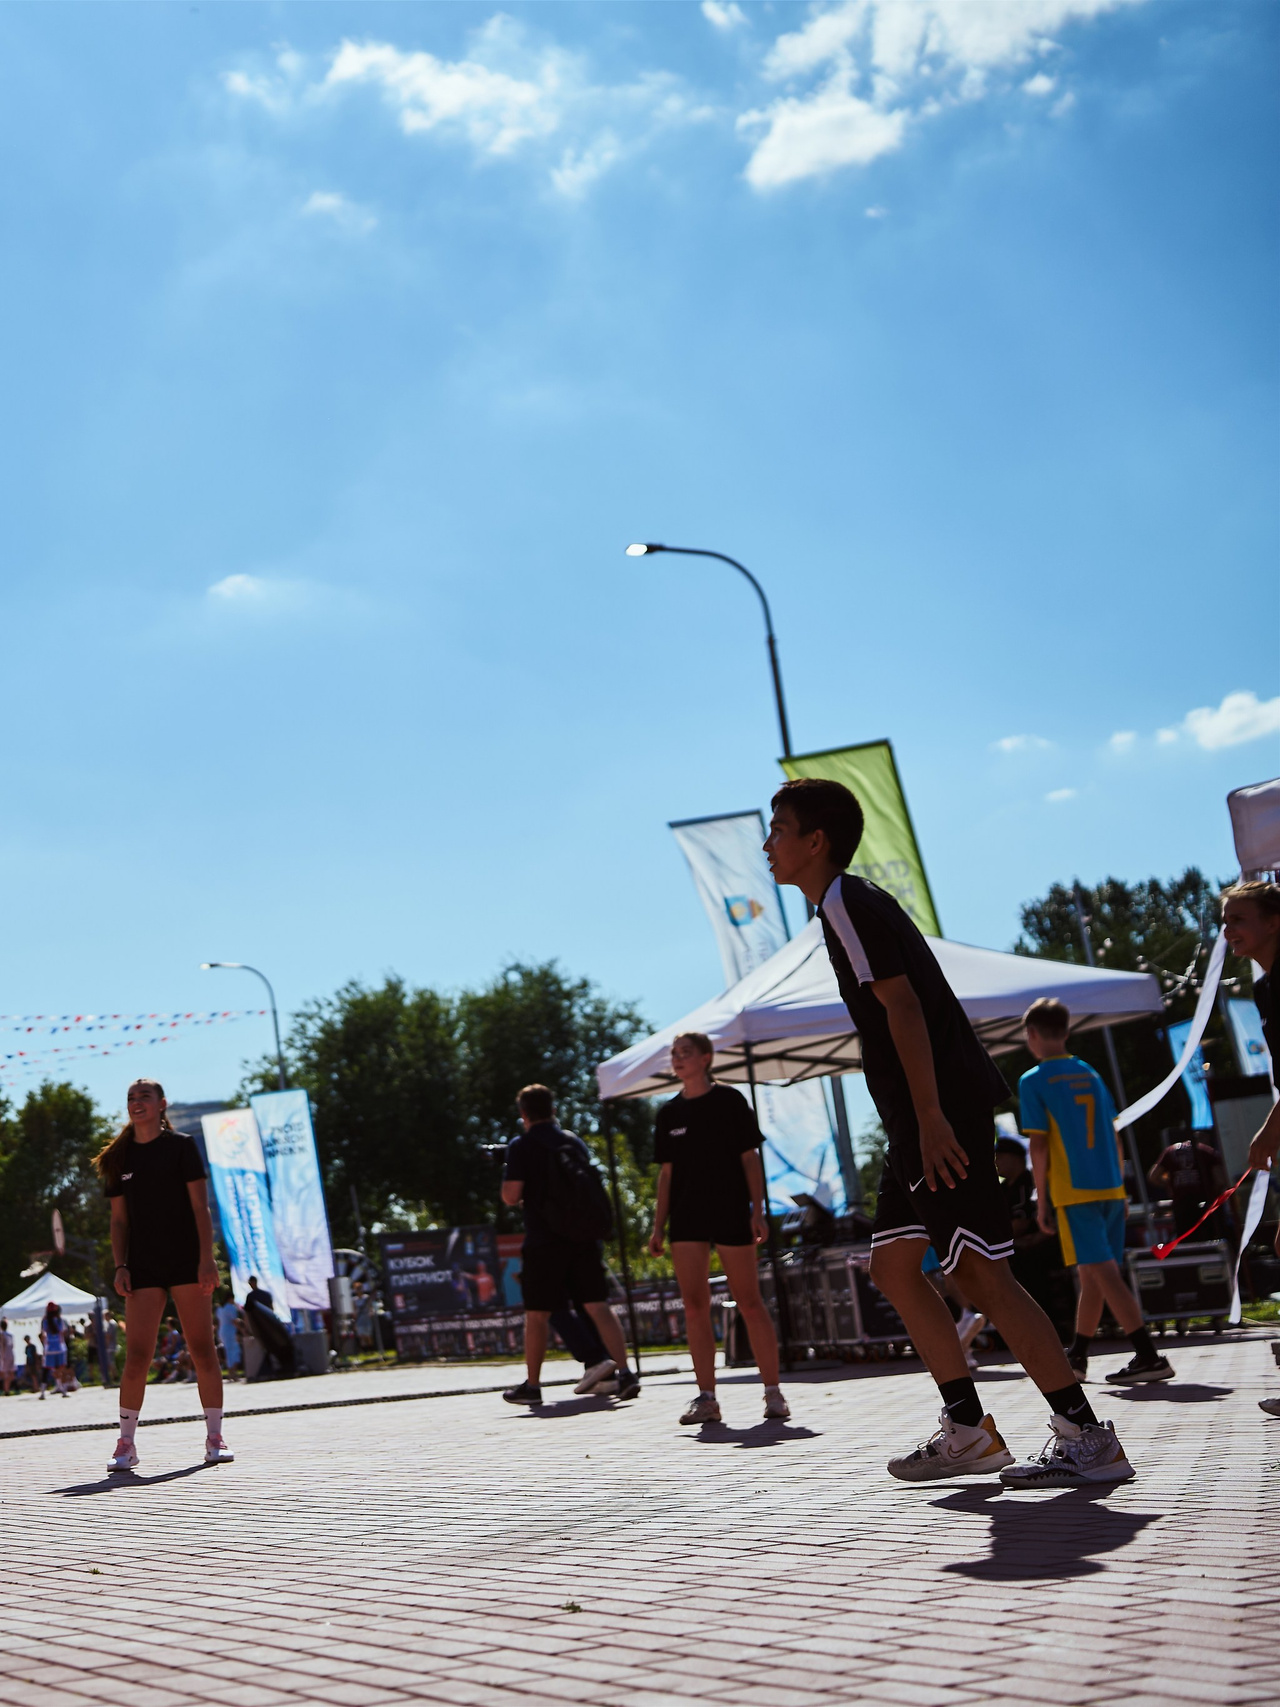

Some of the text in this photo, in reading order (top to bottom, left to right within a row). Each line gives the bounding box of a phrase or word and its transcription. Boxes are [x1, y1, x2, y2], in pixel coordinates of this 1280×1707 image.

[1074, 1094, 1095, 1149] 7
[389, 1255, 435, 1271] КУБОК
[391, 1270, 453, 1286] ПАТРИОТ
